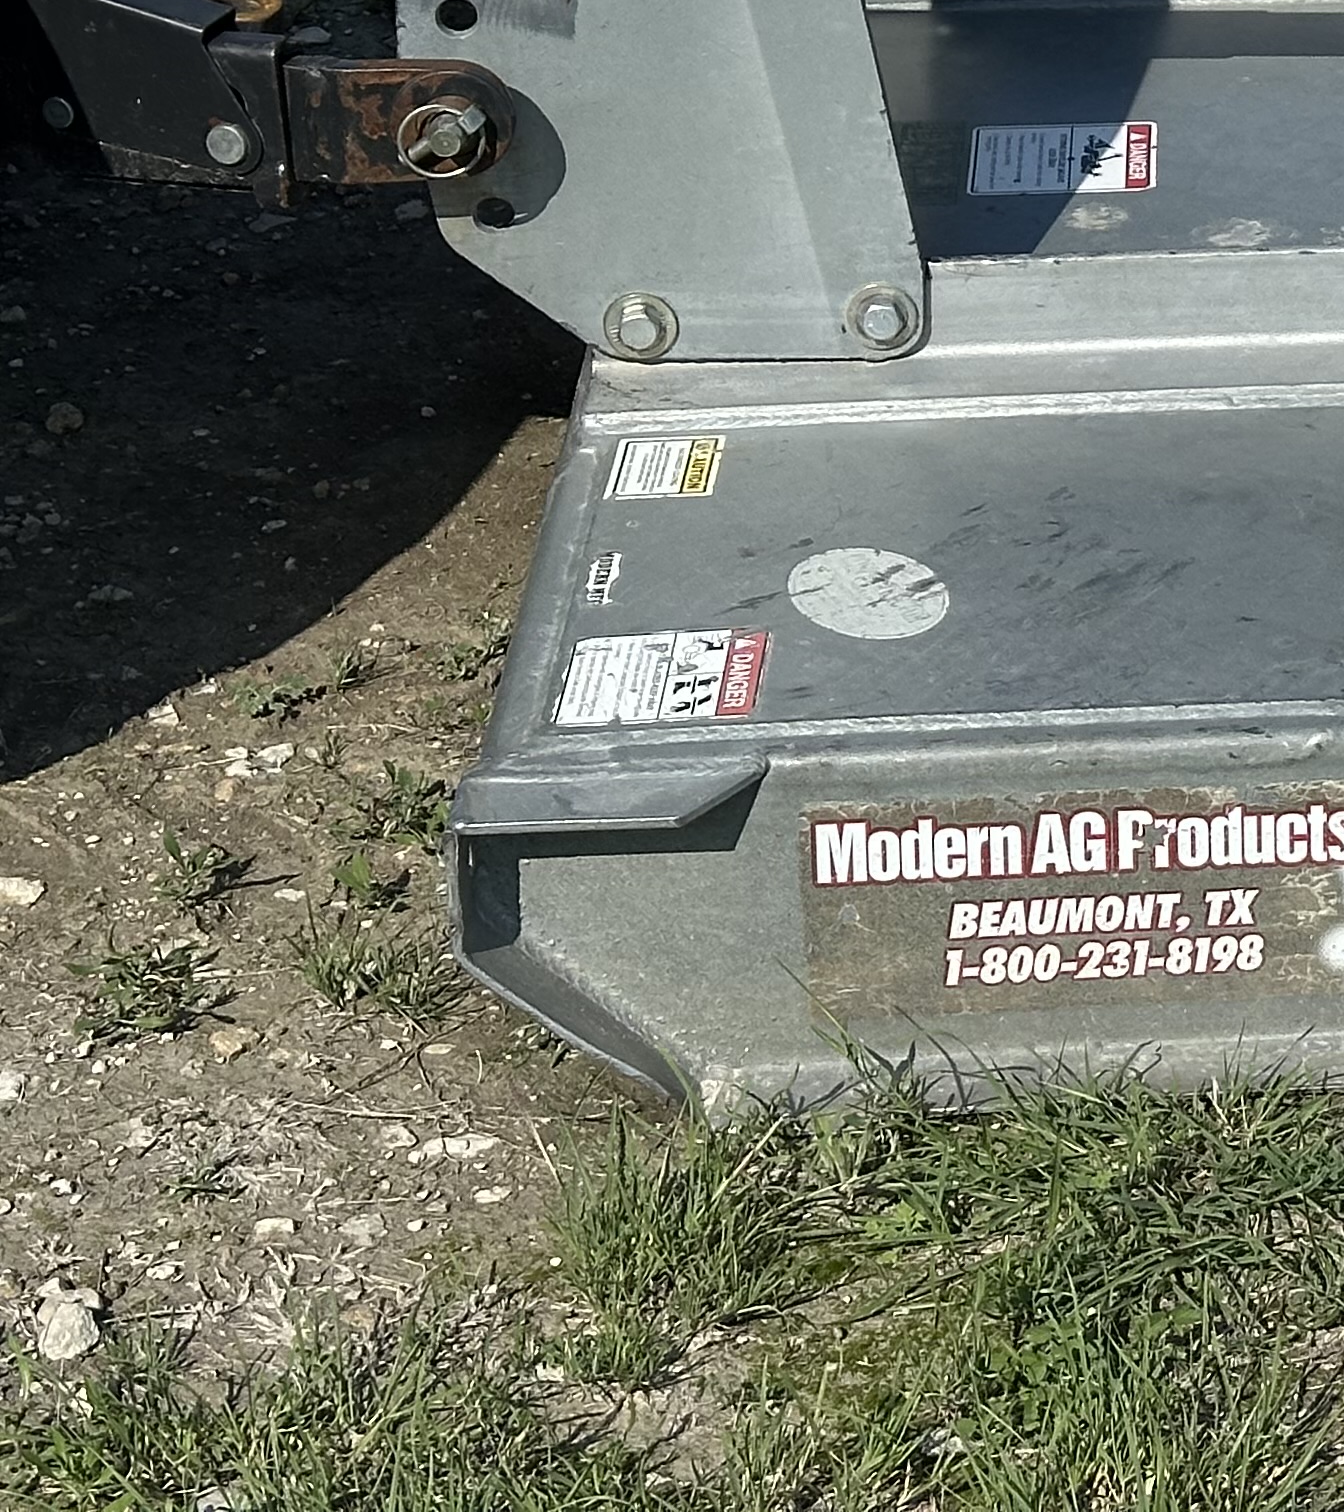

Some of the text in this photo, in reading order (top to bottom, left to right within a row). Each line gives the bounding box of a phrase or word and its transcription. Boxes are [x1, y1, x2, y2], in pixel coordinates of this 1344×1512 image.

[1128, 143, 1148, 180] DANGER
[722, 652, 755, 708] DANGER
[812, 817, 1025, 886] Modern
[1029, 810, 1110, 875] AG
[948, 888, 1260, 940] BEAUMONT, TX
[944, 934, 1266, 987] 1-800-231-8198
